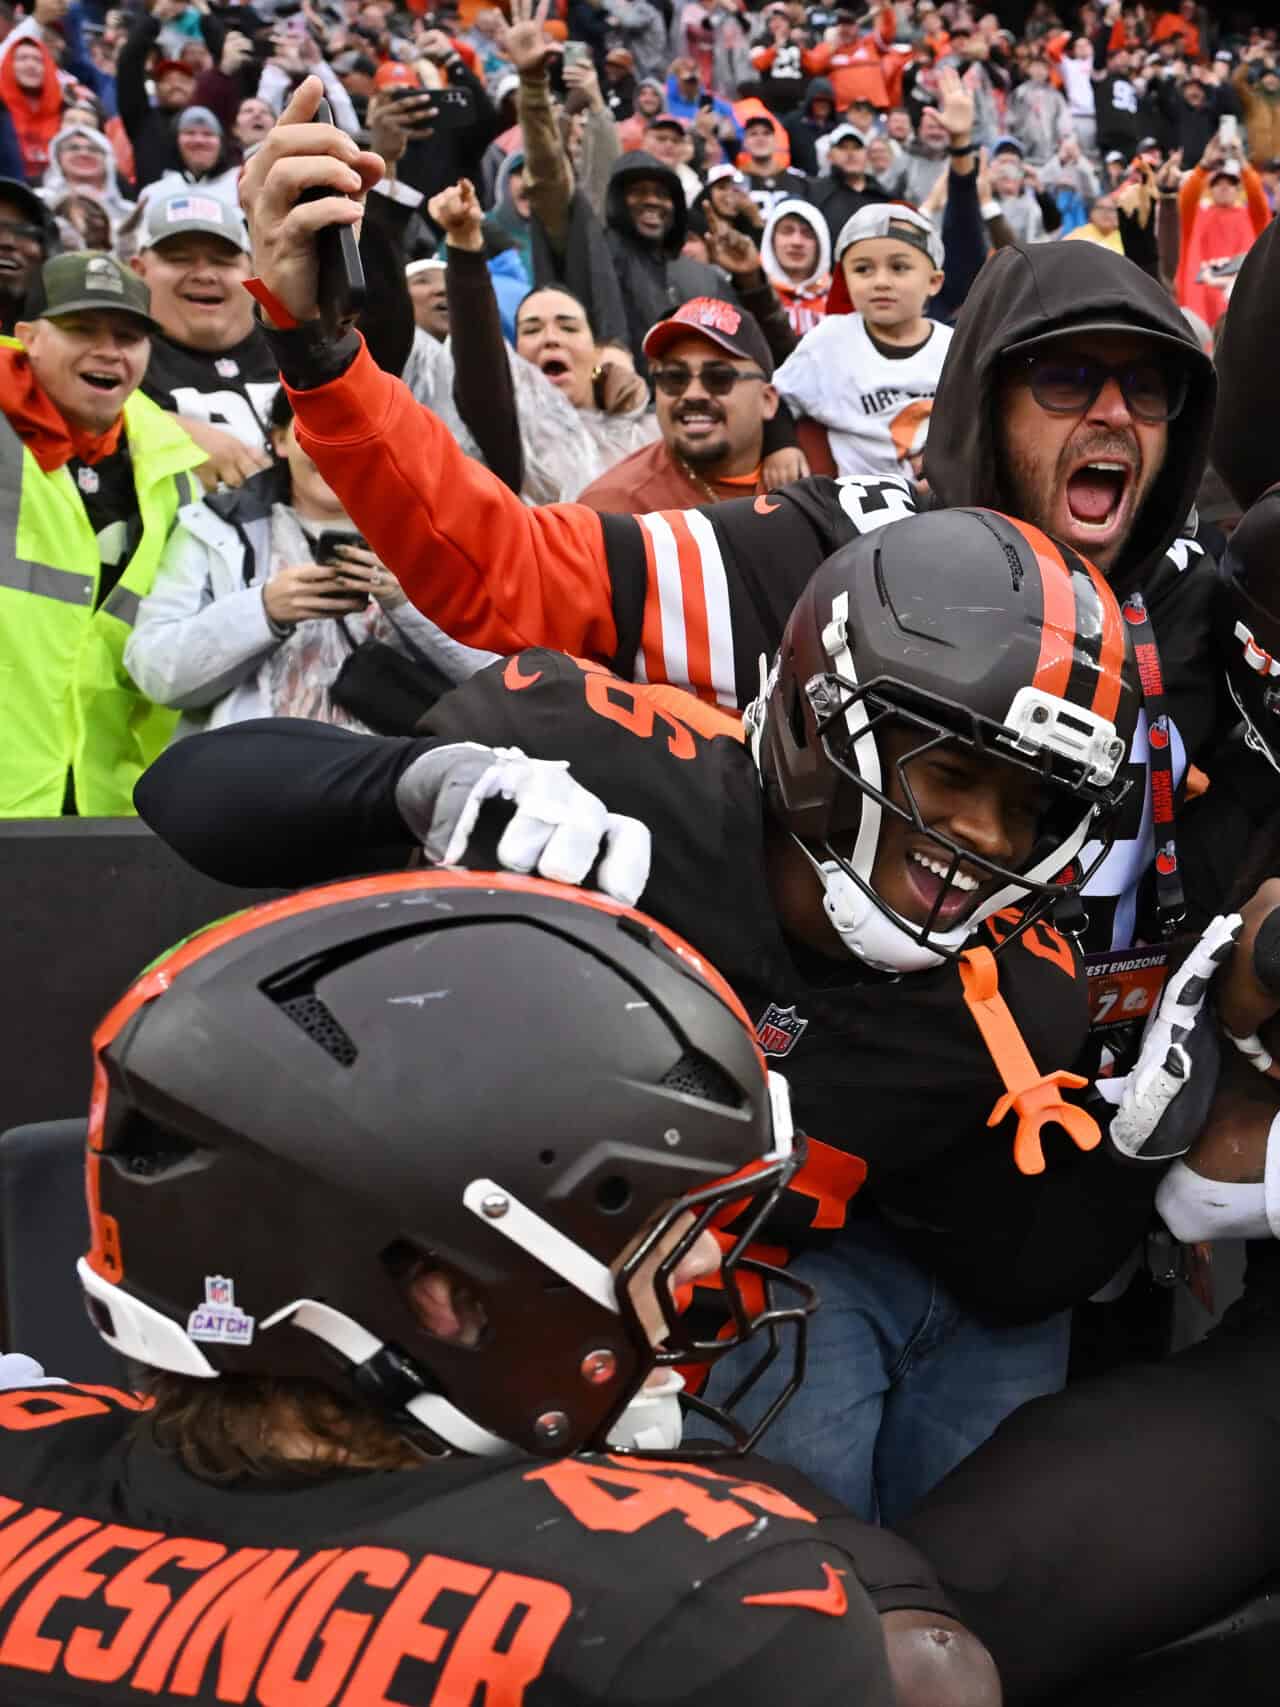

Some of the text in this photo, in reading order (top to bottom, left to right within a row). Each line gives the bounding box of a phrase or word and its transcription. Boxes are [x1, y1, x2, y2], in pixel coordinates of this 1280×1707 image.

[1086, 954, 1168, 977] EST ENDZONE
[192, 1313, 249, 1335] CATCH
